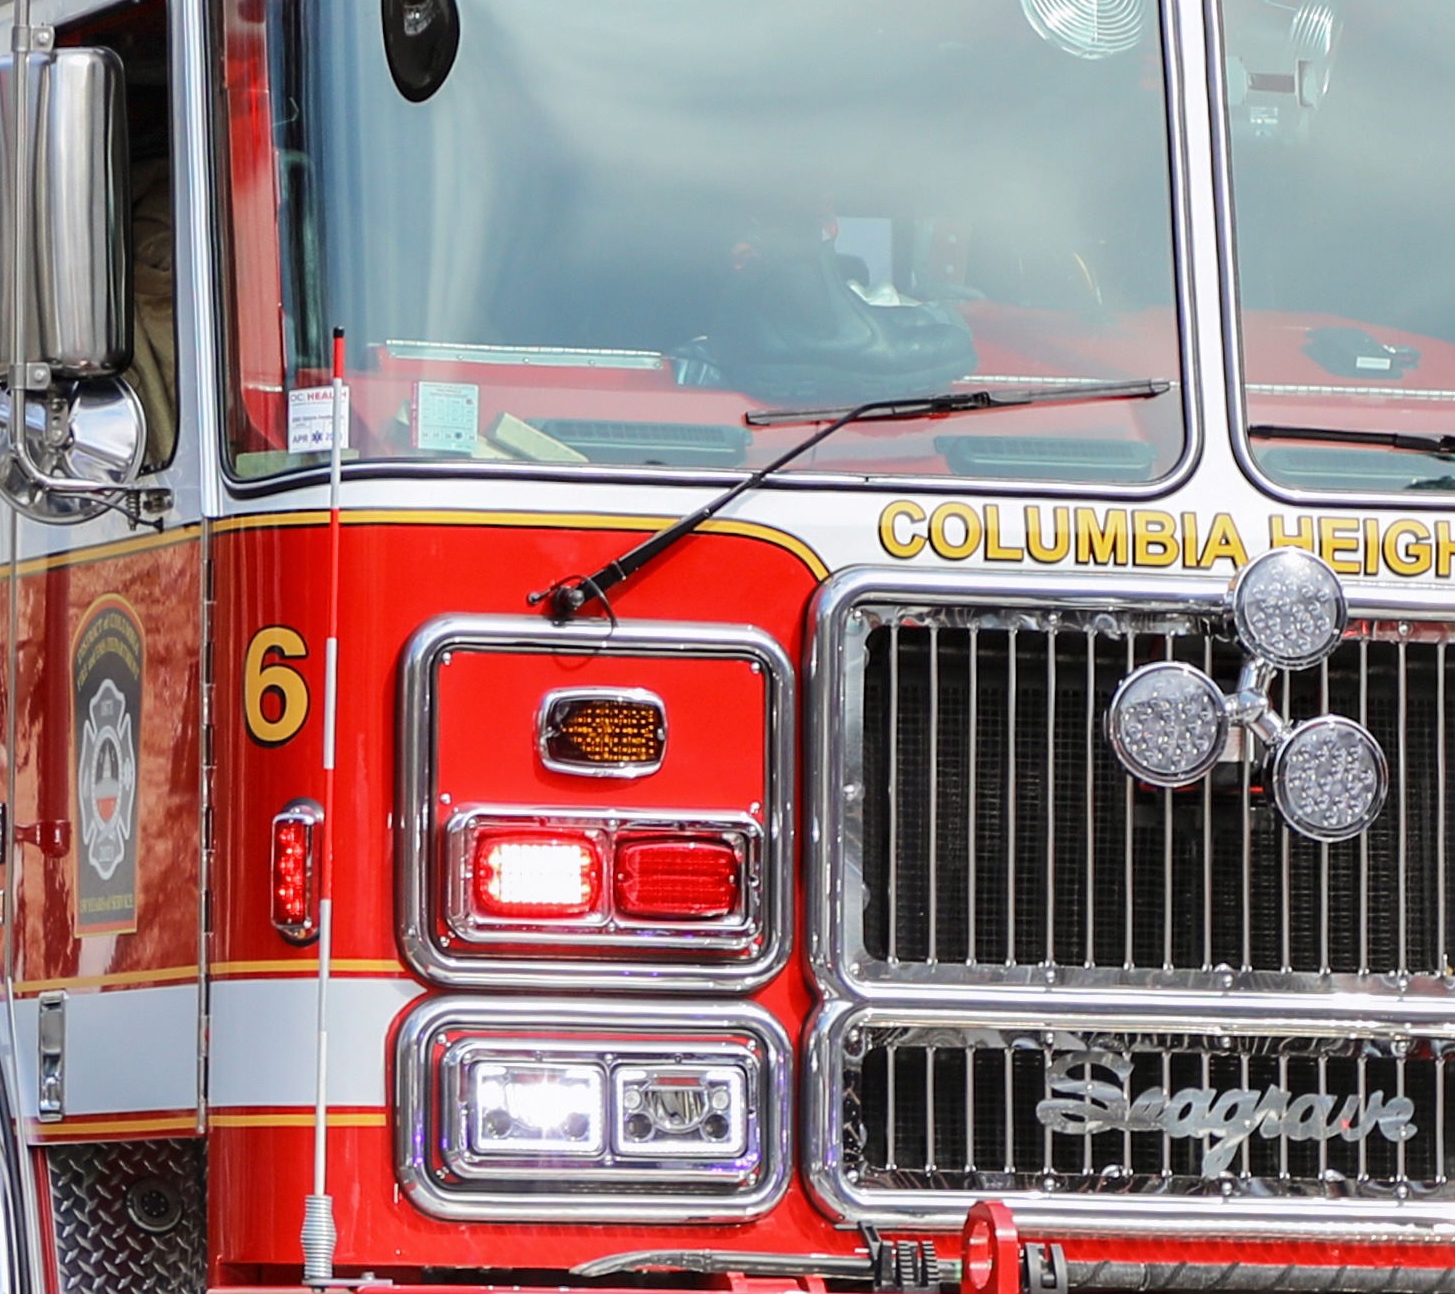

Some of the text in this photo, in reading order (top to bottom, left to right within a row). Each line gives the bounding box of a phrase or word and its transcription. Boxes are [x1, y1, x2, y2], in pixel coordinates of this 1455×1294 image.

[877, 500, 1251, 570] COLUMBIA
[243, 624, 311, 748] 6
[1036, 1050, 1419, 1180] Seagrave
